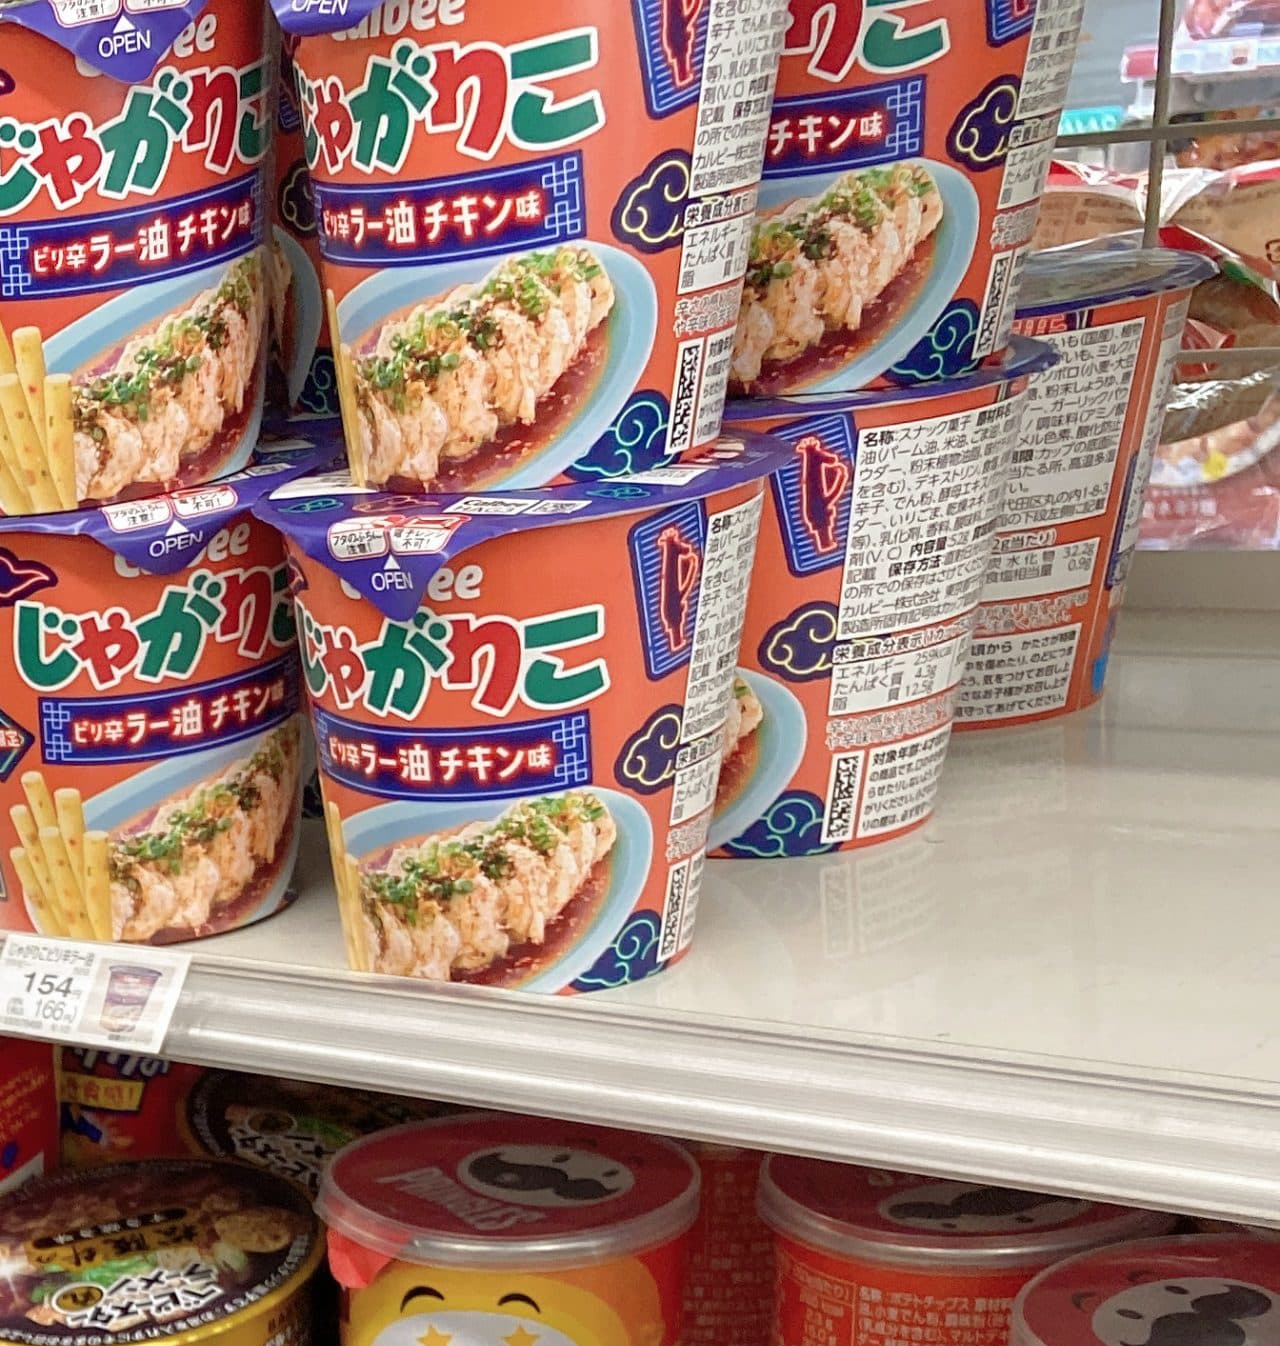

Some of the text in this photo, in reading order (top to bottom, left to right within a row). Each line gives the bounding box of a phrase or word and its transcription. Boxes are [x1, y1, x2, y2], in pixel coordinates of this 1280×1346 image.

[98, 29, 152, 58] OPEN
[149, 531, 203, 558] OPEN
[371, 572, 414, 592] OPEN
[294, 604, 611, 721] じゃがりこ
